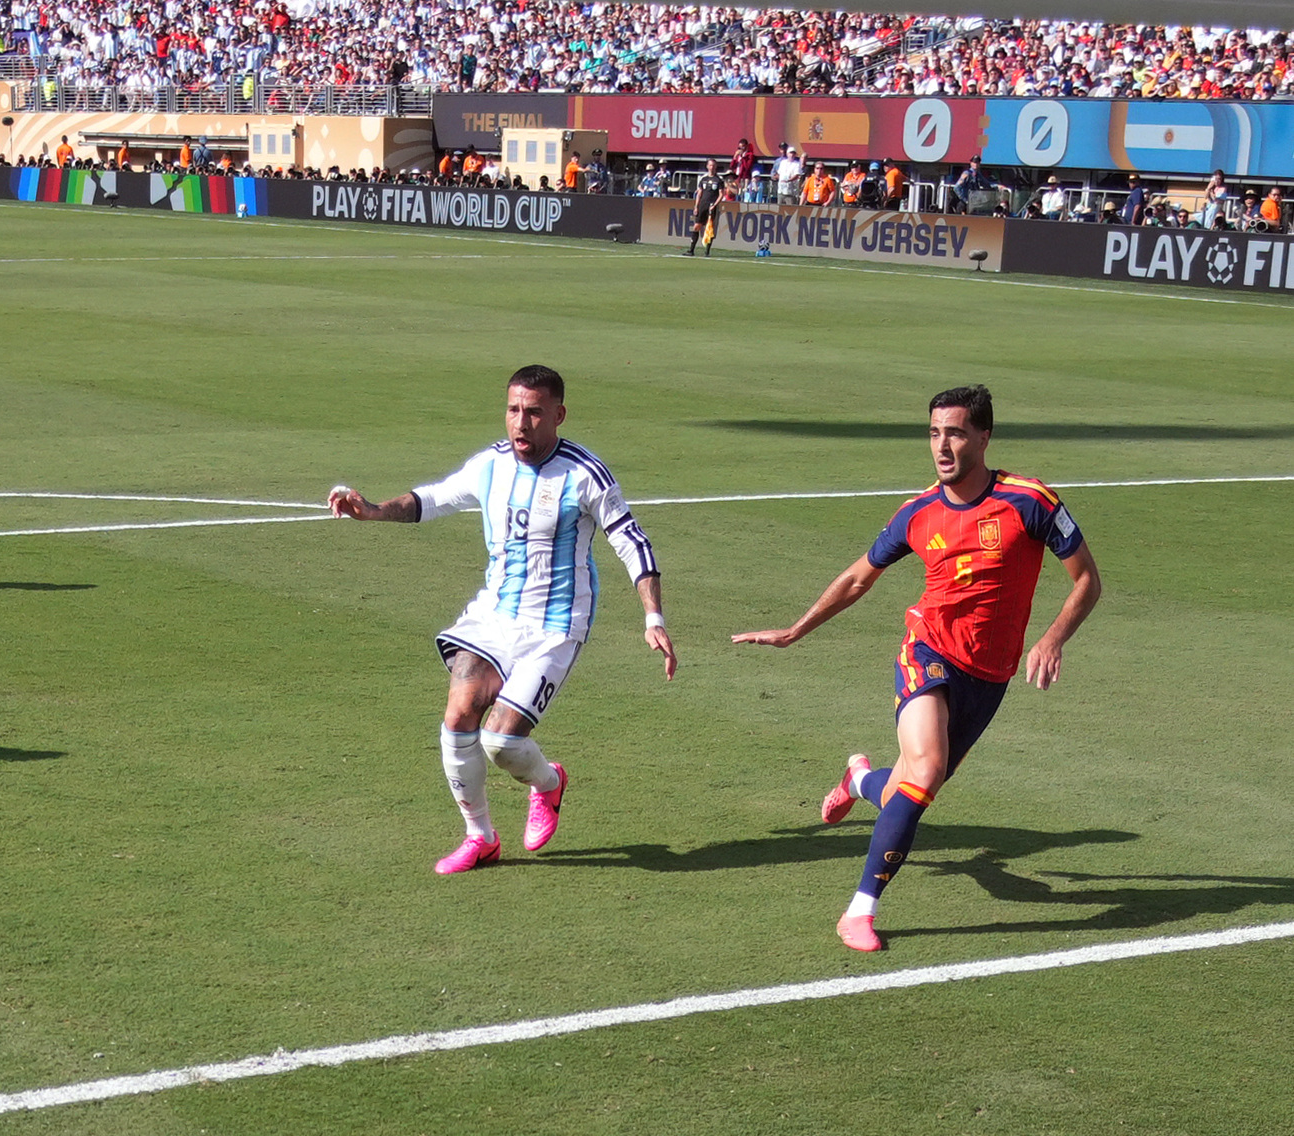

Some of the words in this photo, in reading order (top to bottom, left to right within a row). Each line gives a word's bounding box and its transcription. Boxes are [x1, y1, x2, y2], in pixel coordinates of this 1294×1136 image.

[462, 112, 496, 132] THE
[630, 109, 694, 139] SPAIN
[902, 98, 952, 163] 0
[1015, 99, 1069, 167] 0
[312, 184, 362, 219] PLAY
[381, 188, 427, 223] FIFA
[430, 191, 511, 229] WORLD
[726, 212, 792, 245] YORK
[798, 214, 856, 250] NEW
[861, 220, 968, 258] JERSEY
[1103, 230, 1204, 281] PLAY
[505, 506, 530, 541] 19
[531, 675, 556, 713] 19
